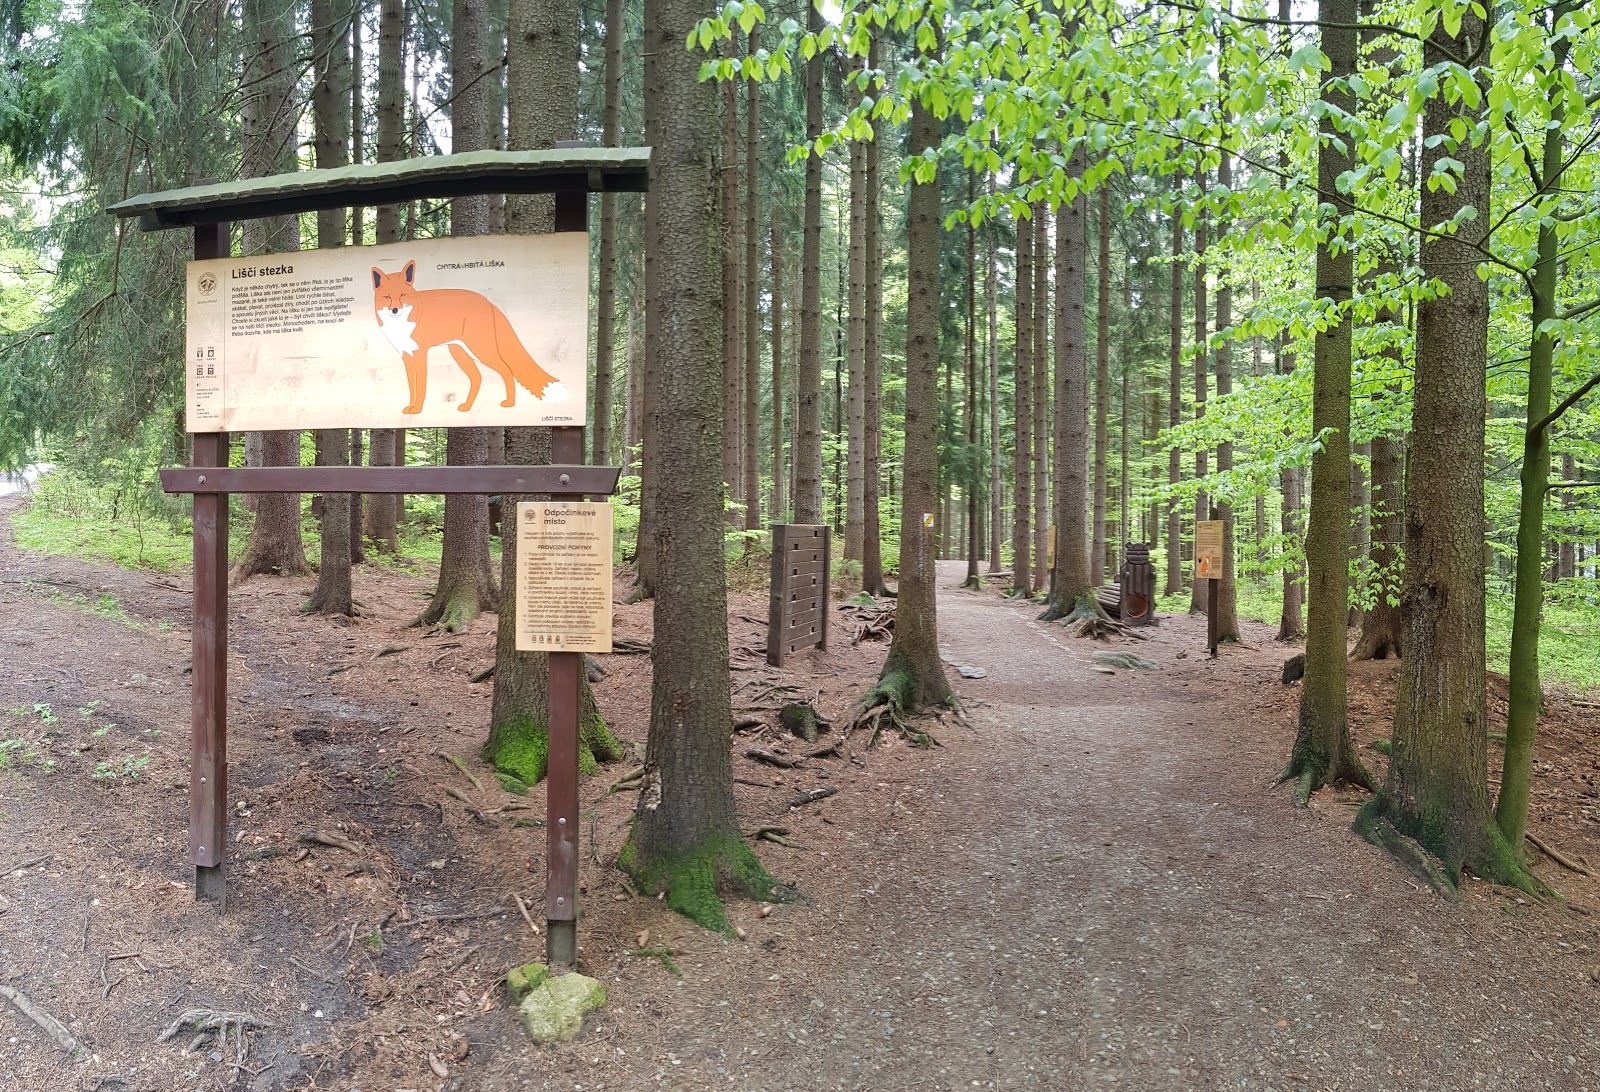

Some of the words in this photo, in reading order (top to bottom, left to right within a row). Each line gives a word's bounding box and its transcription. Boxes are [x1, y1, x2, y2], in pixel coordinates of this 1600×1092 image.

[437, 261, 461, 270] CHYTRÁ
[464, 260, 484, 269] HBITÁ
[485, 259, 505, 268] LIŠKA
[232, 266, 256, 279] Liščí
[259, 265, 294, 276] stezka
[544, 509, 596, 517] Odpočinkové
